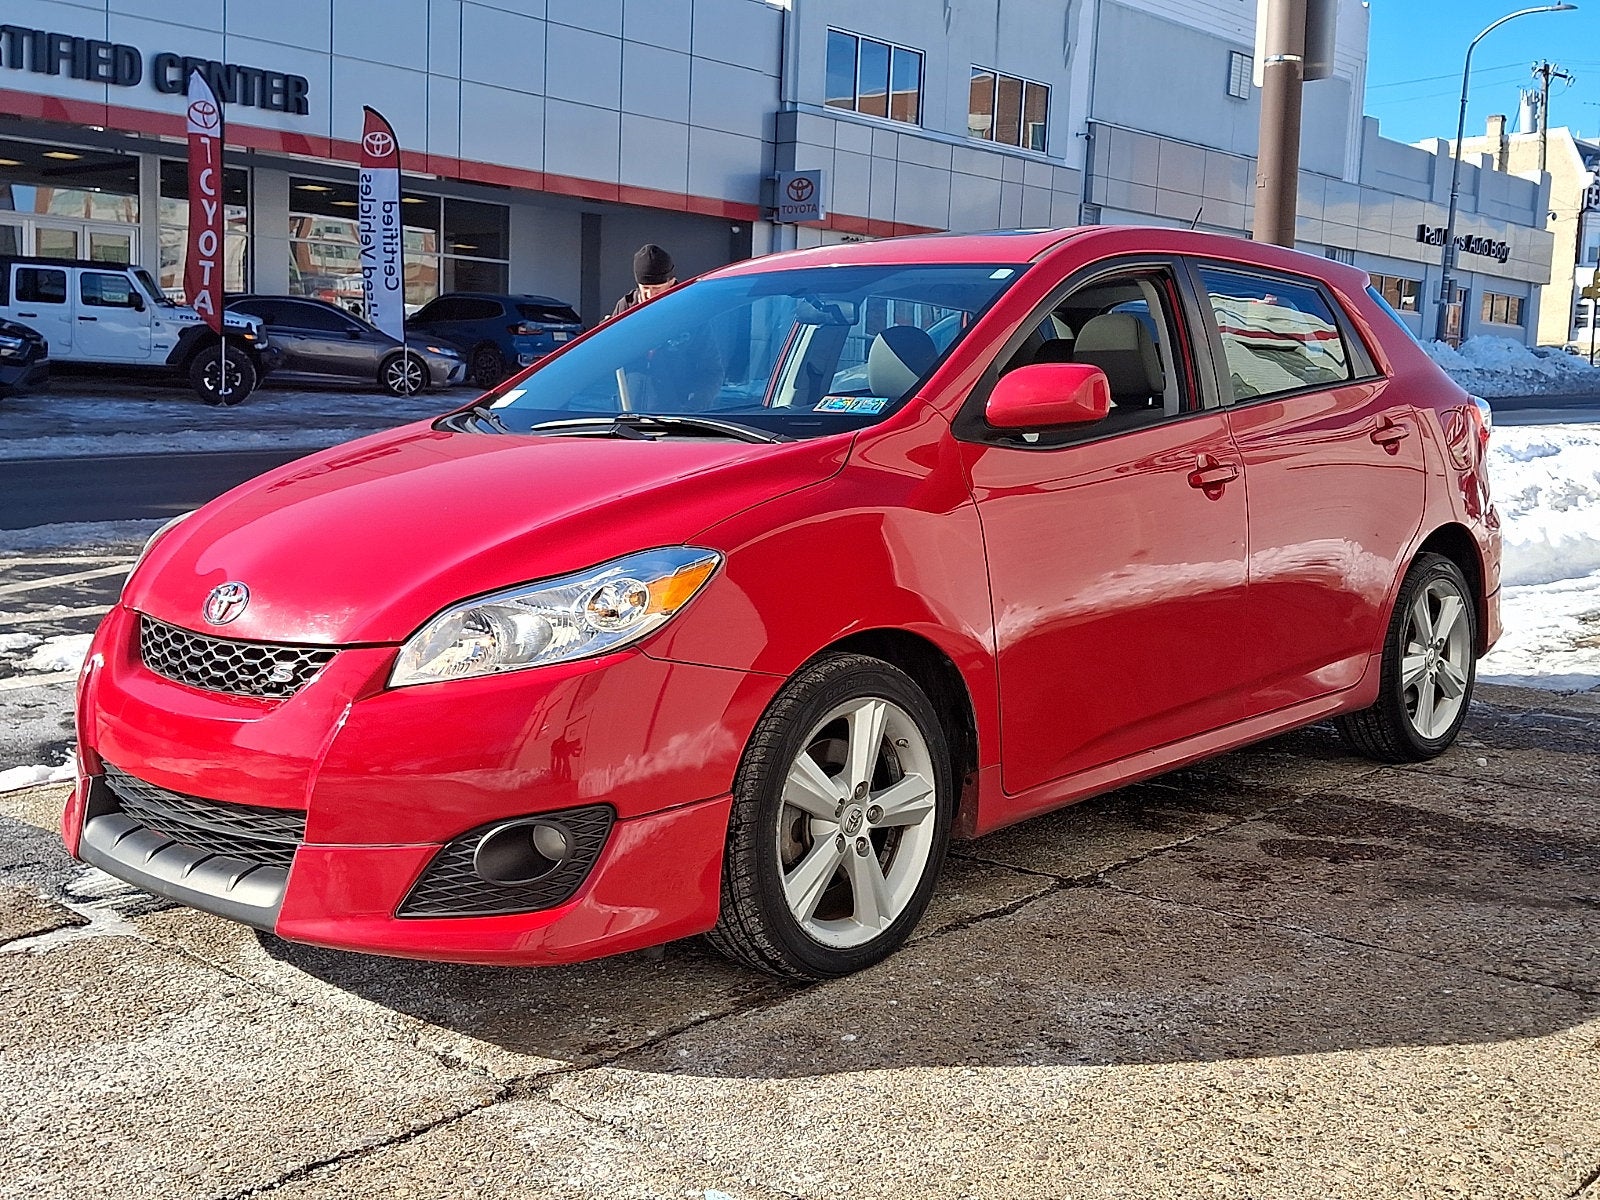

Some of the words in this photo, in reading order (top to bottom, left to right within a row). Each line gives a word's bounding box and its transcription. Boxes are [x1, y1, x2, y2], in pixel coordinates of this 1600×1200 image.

[0, 24, 142, 87] TIFIED
[781, 203, 818, 214] TOYOTA
[270, 662, 297, 682] S
